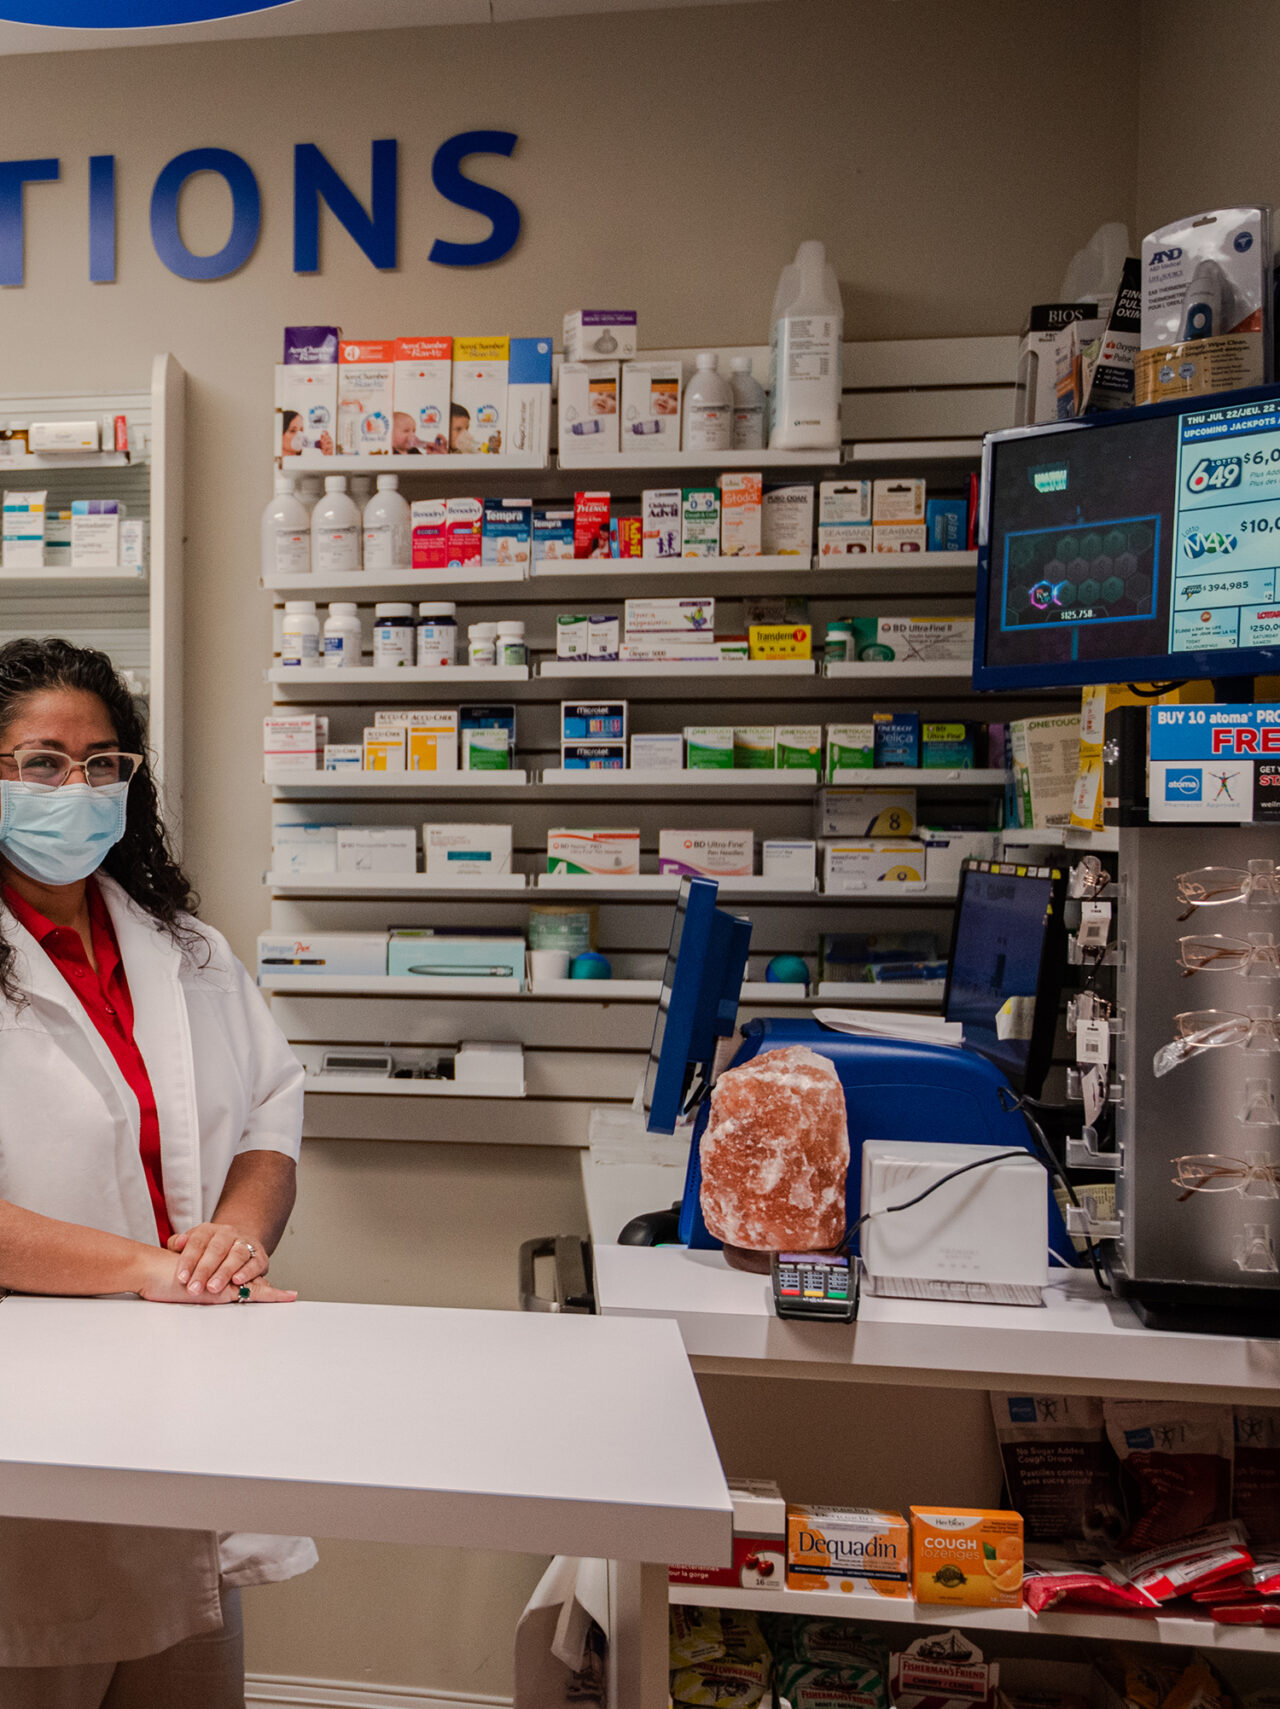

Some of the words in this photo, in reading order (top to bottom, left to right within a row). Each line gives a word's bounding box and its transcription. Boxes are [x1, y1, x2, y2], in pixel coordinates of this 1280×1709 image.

[1049, 310, 1084, 322] BIOS
[1187, 415, 1205, 424] THU
[1207, 412, 1224, 421] JUL
[1263, 404, 1276, 412] 22
[1184, 425, 1228, 438] UPCOMING
[1230, 417, 1276, 431] JACKPOTS
[1211, 458, 1238, 466] LOTTO
[485, 509, 523, 523] Tempra
[648, 507, 679, 519] Advil
[533, 519, 562, 529] Tempra
[1184, 532, 1236, 559] MAX
[1208, 581, 1249, 592] 394,985
[893, 624, 907, 632] BD
[757, 631, 795, 641] Transderm
[1158, 711, 1185, 724] BUY
[1188, 711, 1206, 724] 10
[889, 813, 901, 831] 8
[693, 840, 706, 848] BD
[798, 1531, 898, 1560] Dequadin
[924, 1537, 977, 1551] COUGH
[920, 1548, 980, 1562] lozenges
[688, 1572, 709, 1580] gorge
[755, 1578, 765, 1586] 16
[902, 1661, 955, 1676] FISHERMAN'S
[954, 1667, 986, 1679] FRIEND
